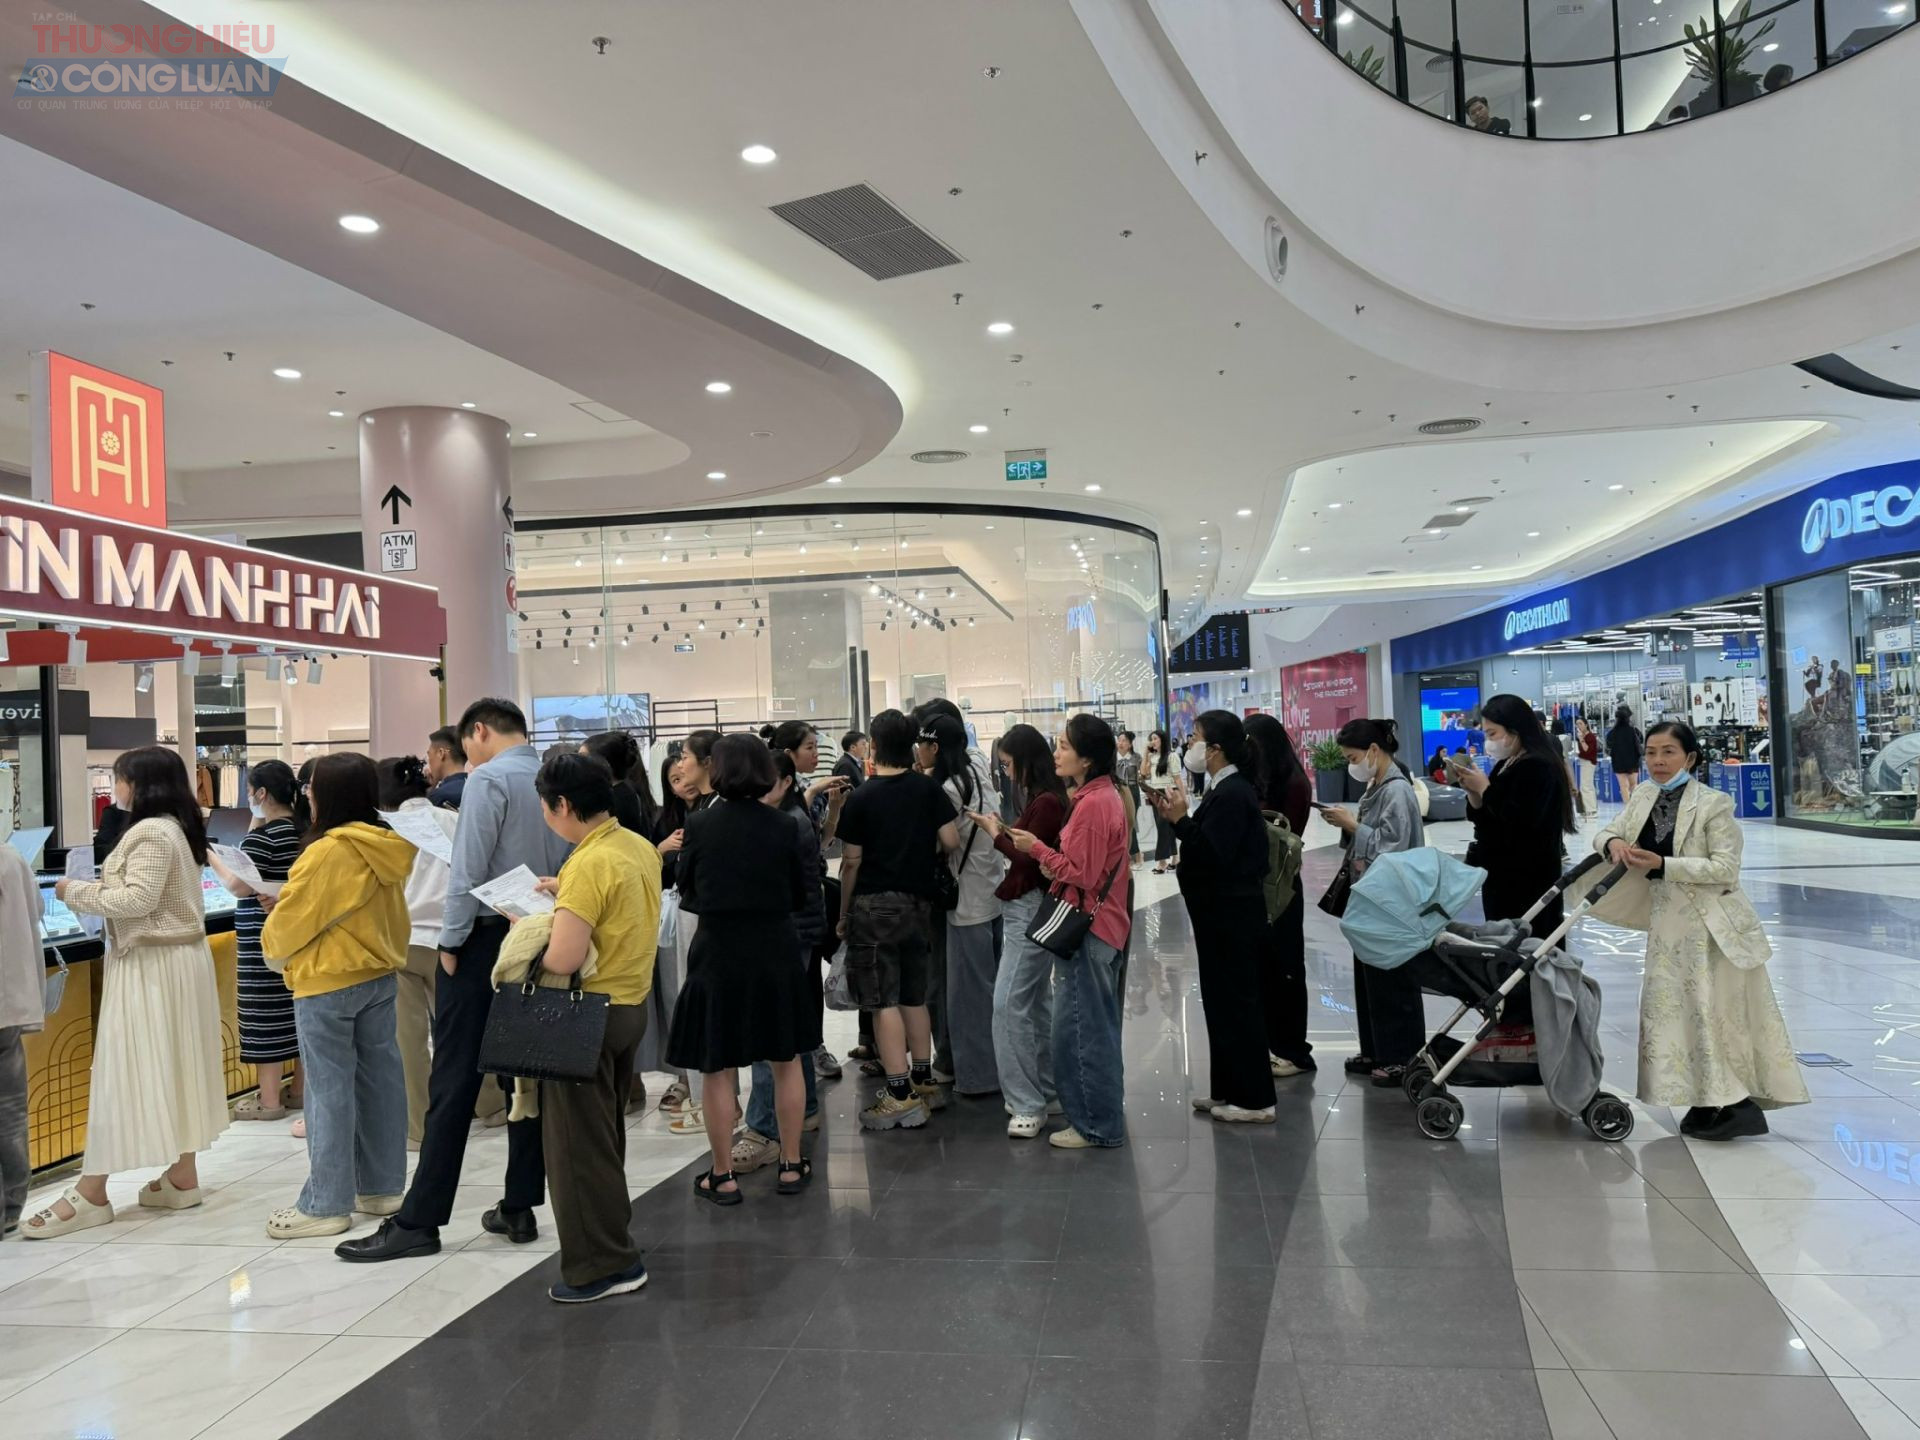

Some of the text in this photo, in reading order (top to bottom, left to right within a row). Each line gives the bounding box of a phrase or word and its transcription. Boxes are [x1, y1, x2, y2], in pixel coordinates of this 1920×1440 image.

[1829, 485, 1920, 539] DEC
[384, 534, 413, 547] ATM
[1515, 598, 1569, 635] DECATHLON
